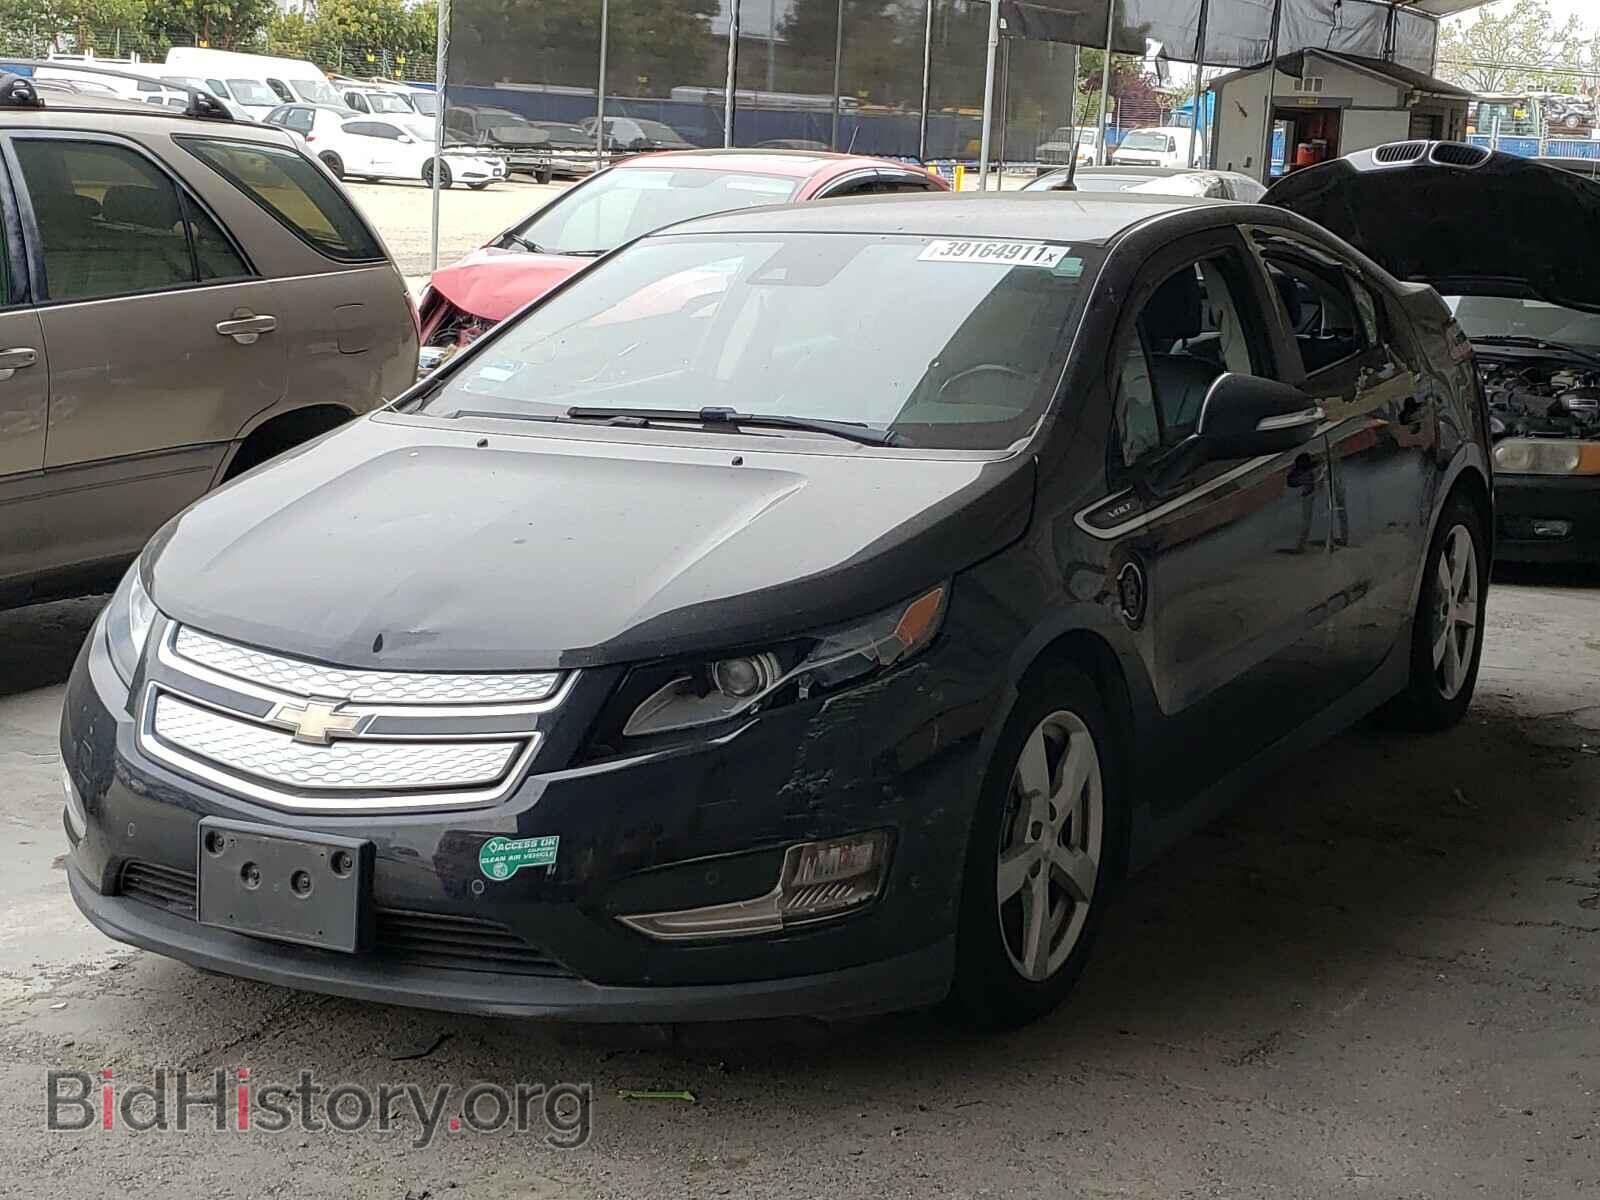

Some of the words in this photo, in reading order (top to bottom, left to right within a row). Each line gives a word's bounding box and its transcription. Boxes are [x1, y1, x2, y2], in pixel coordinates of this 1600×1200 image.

[496, 840, 538, 851] ACCESS
[540, 837, 555, 846] OK
[481, 856, 506, 864] CLEAN
[523, 850, 554, 859] VEHICLE
